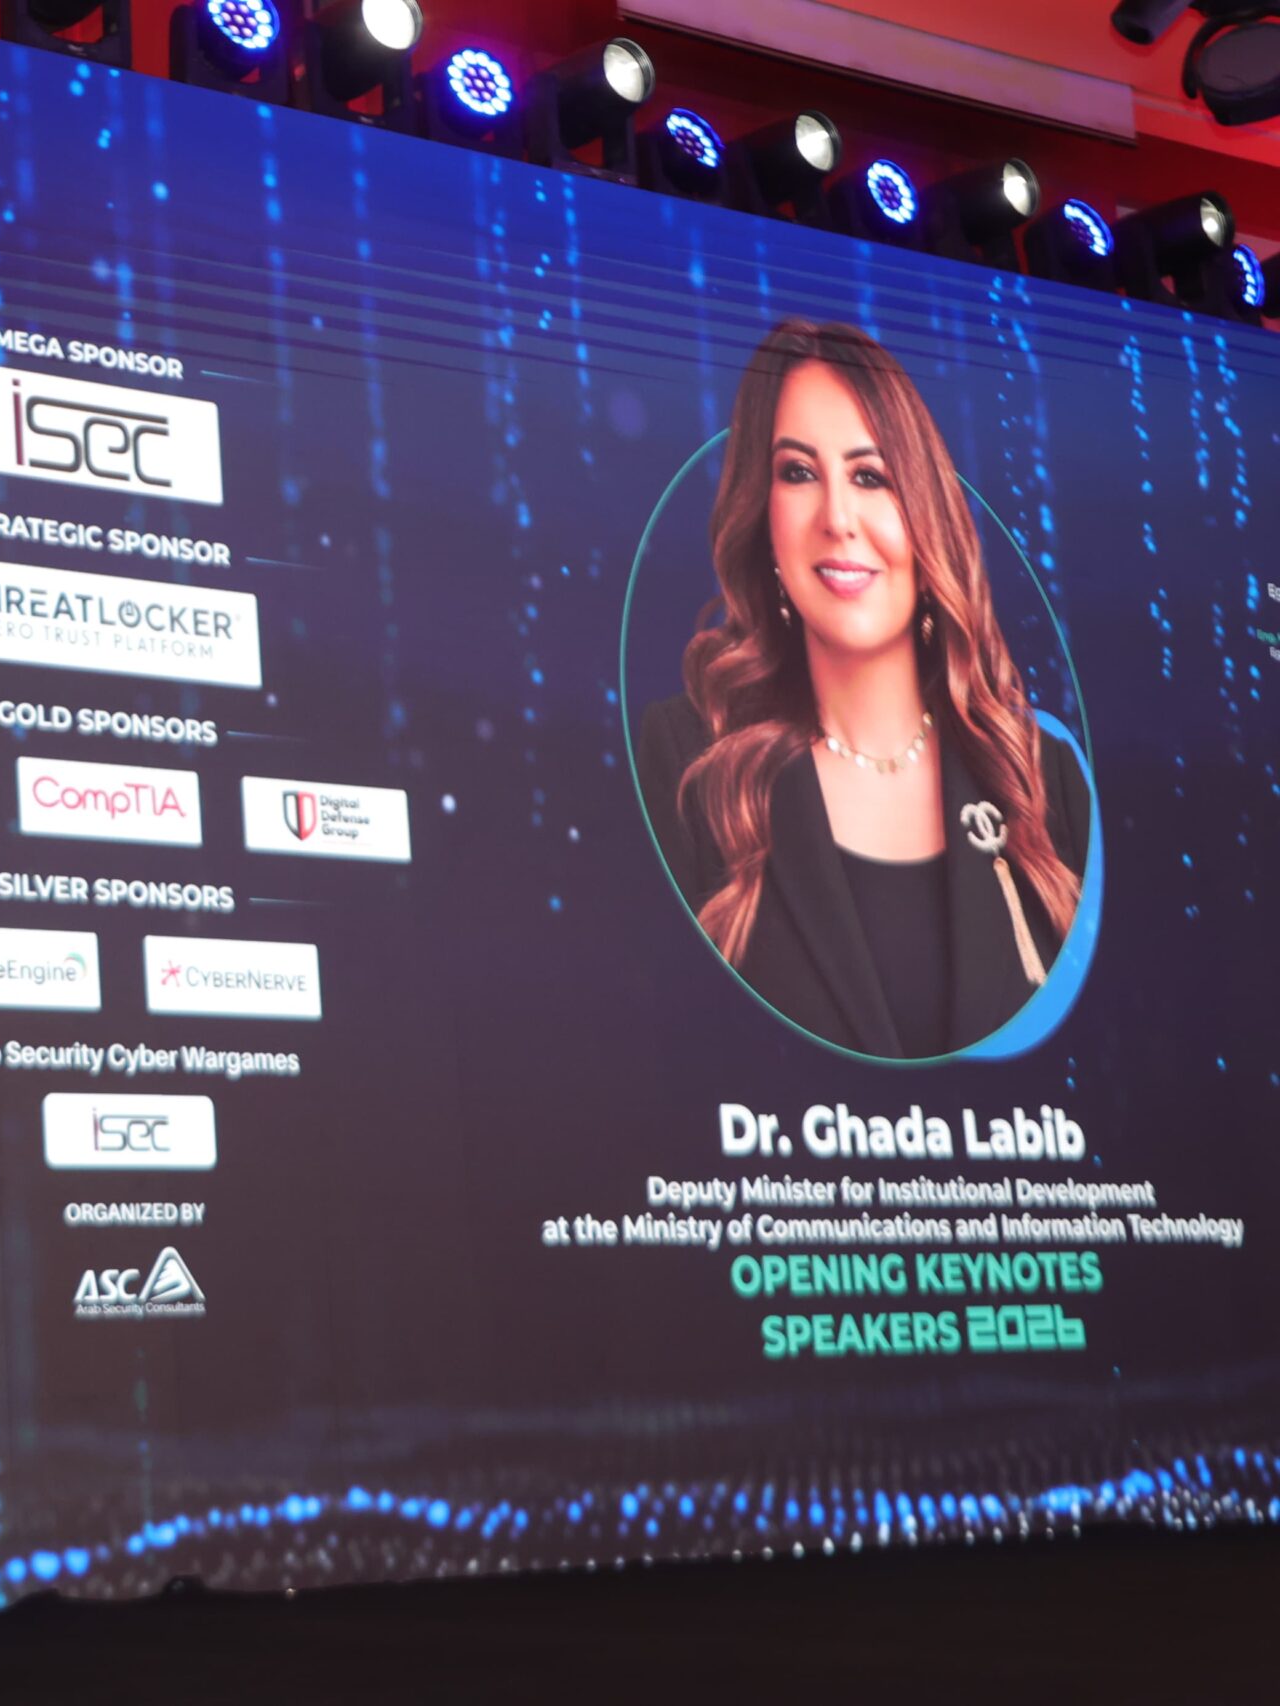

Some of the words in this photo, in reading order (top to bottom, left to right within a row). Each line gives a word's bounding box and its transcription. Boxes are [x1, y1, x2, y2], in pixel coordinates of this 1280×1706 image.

[66, 341, 184, 379] SPONSOR
[107, 529, 231, 566] SPONSOR
[44, 625, 101, 647] TRUST
[114, 635, 214, 660] PLATFORM
[77, 709, 219, 746] SPONSORS
[32, 775, 187, 820] CompTIA
[320, 795, 360, 811] Digital
[320, 809, 370, 825] Defense
[321, 823, 359, 840] Group
[93, 876, 235, 913] SPONSORS
[3, 1040, 104, 1076] Security
[107, 1043, 178, 1077] Cyber
[180, 1045, 300, 1080] Wargames
[719, 1102, 793, 1157] Dr.
[802, 1103, 954, 1160] Ghada
[962, 1104, 1086, 1161] Labib
[646, 1175, 737, 1212] Deputy
[740, 1174, 837, 1207] Minister
[840, 1175, 874, 1207] for
[878, 1175, 1013, 1207] Institutional
[1015, 1177, 1157, 1211] Development
[64, 1202, 179, 1226] ORGANIZED
[180, 1202, 205, 1226] BY
[542, 1215, 571, 1245] at
[573, 1213, 619, 1245] the
[622, 1211, 722, 1251] Ministry
[726, 1213, 754, 1245] of
[755, 1211, 953, 1245] Communications
[955, 1213, 999, 1244] and
[1001, 1211, 1126, 1243] Information
[1127, 1212, 1244, 1249] Technology
[74, 1268, 140, 1303] ASC
[731, 1253, 909, 1298] OPENING
[915, 1251, 1104, 1295] KEYNOTES
[76, 1303, 101, 1315] Arab
[103, 1303, 143, 1317] Security
[145, 1301, 206, 1314] Consultants
[761, 1311, 961, 1358] SPEAKERS
[965, 1303, 1087, 1350] 2026
